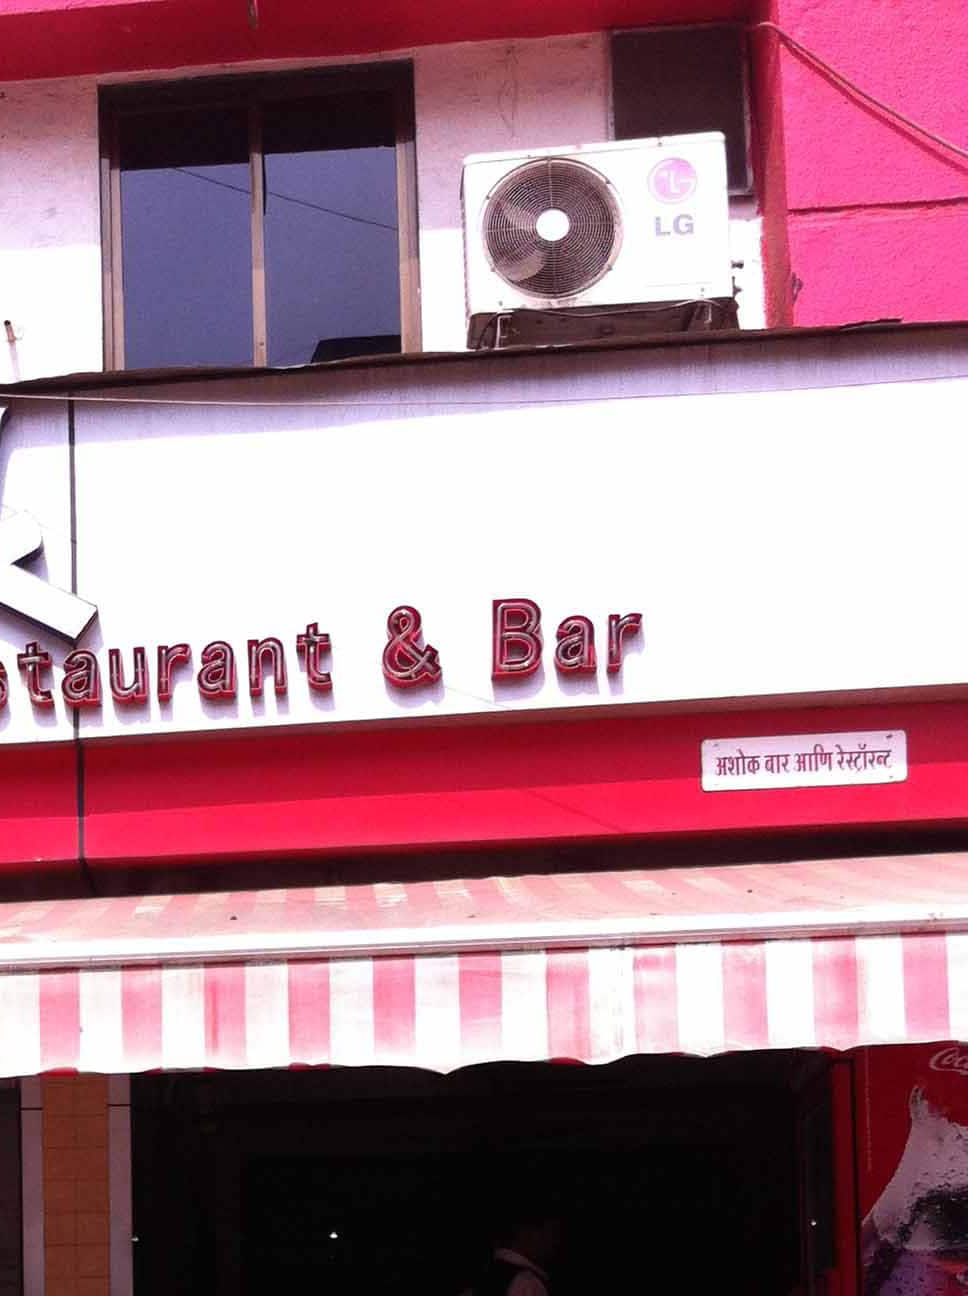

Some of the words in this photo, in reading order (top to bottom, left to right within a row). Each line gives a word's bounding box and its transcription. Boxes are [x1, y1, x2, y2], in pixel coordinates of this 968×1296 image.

[655, 214, 694, 237] LG
[381, 605, 442, 689] &
[491, 598, 643, 682] Bar
[716, 748, 760, 776] अशोक
[794, 743, 833, 772] आणि
